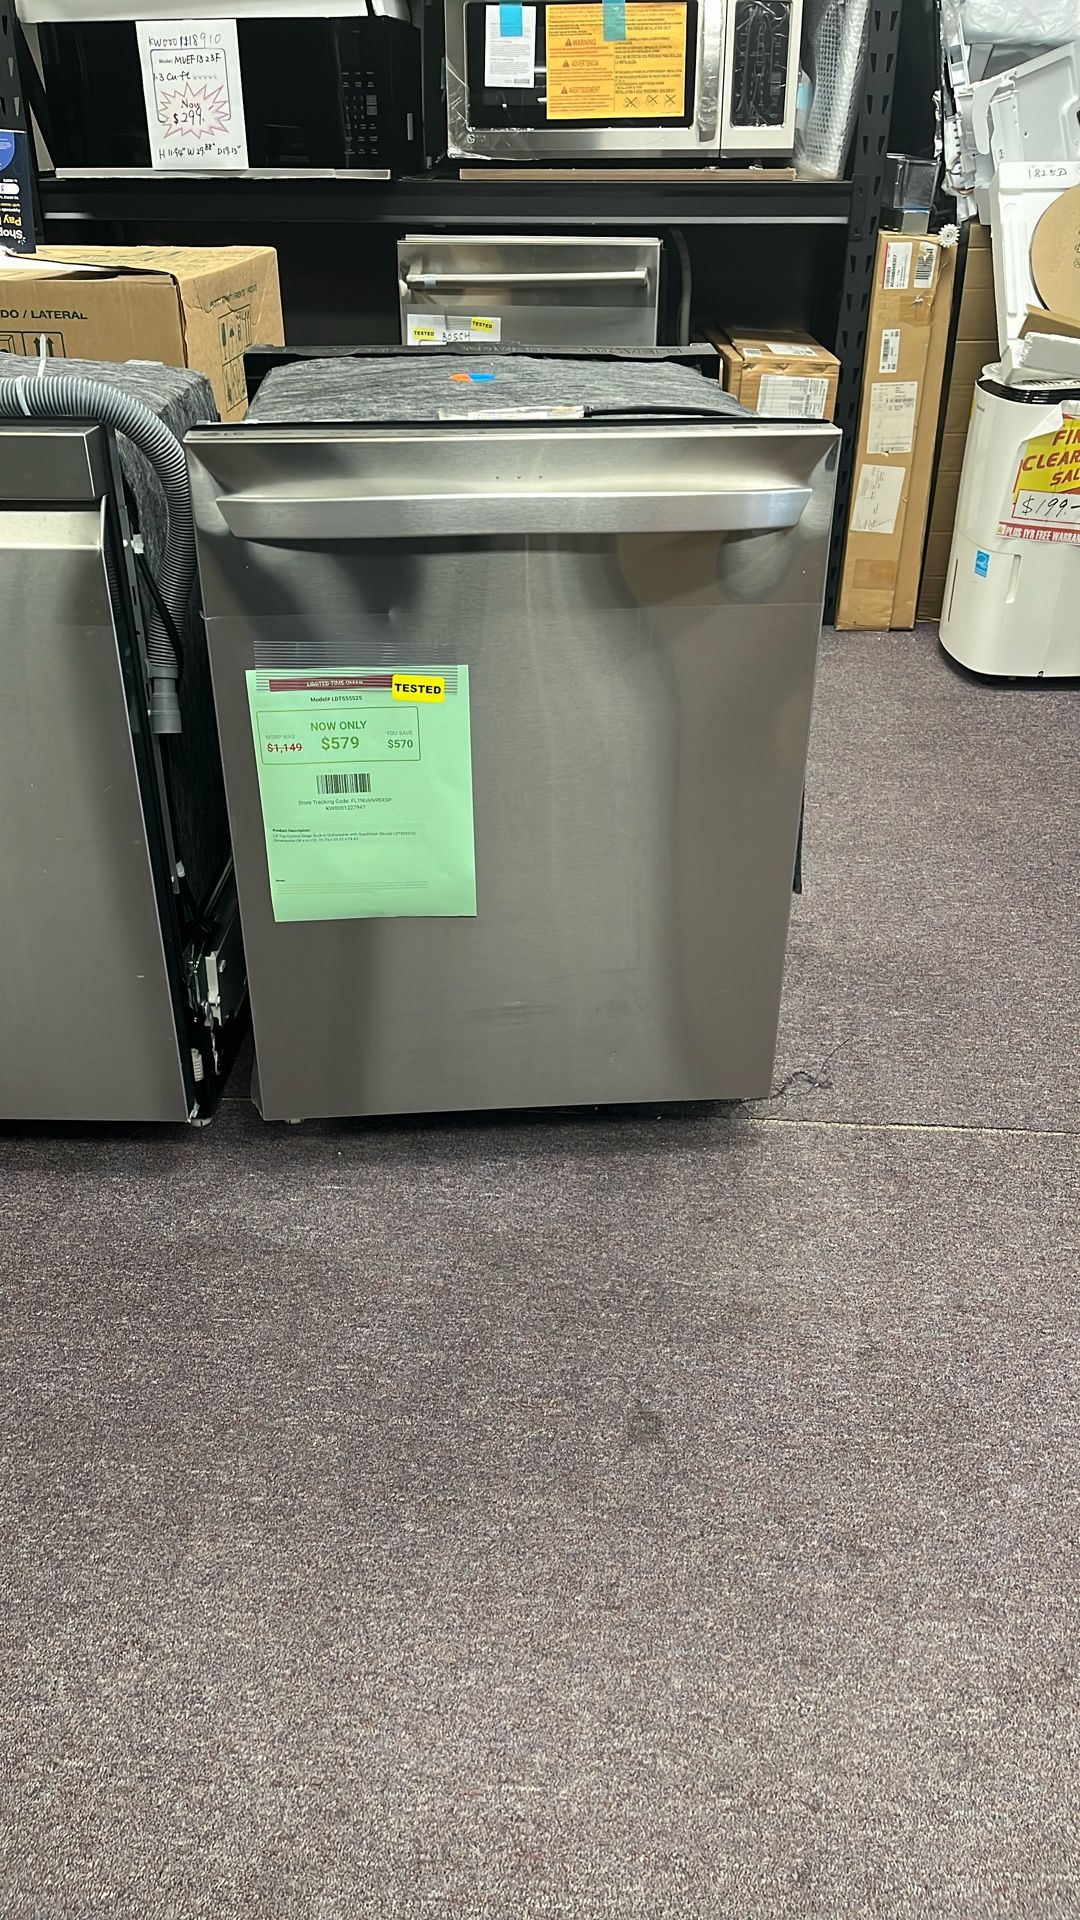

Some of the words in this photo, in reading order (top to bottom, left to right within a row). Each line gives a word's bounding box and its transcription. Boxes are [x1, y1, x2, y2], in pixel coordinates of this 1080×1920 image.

[174, 53, 221, 65] MVEF1323F
[3, 214, 22, 226] Pay
[0, 310, 19, 318] DO
[31, 310, 88, 319] LATERAL
[472, 320, 493, 329] TESTED
[442, 331, 471, 342] BOSCH
[1050, 468, 1080, 486] SAL
[1005, 526, 1023, 537] PLUS
[1035, 529, 1052, 540] FREE
[395, 683, 441, 694] TESTED
[310, 721, 336, 731] NOW
[339, 720, 367, 730] ONLY
[267, 742, 303, 754] $1,149
[321, 736, 360, 751] $579
[387, 738, 414, 749] $570
